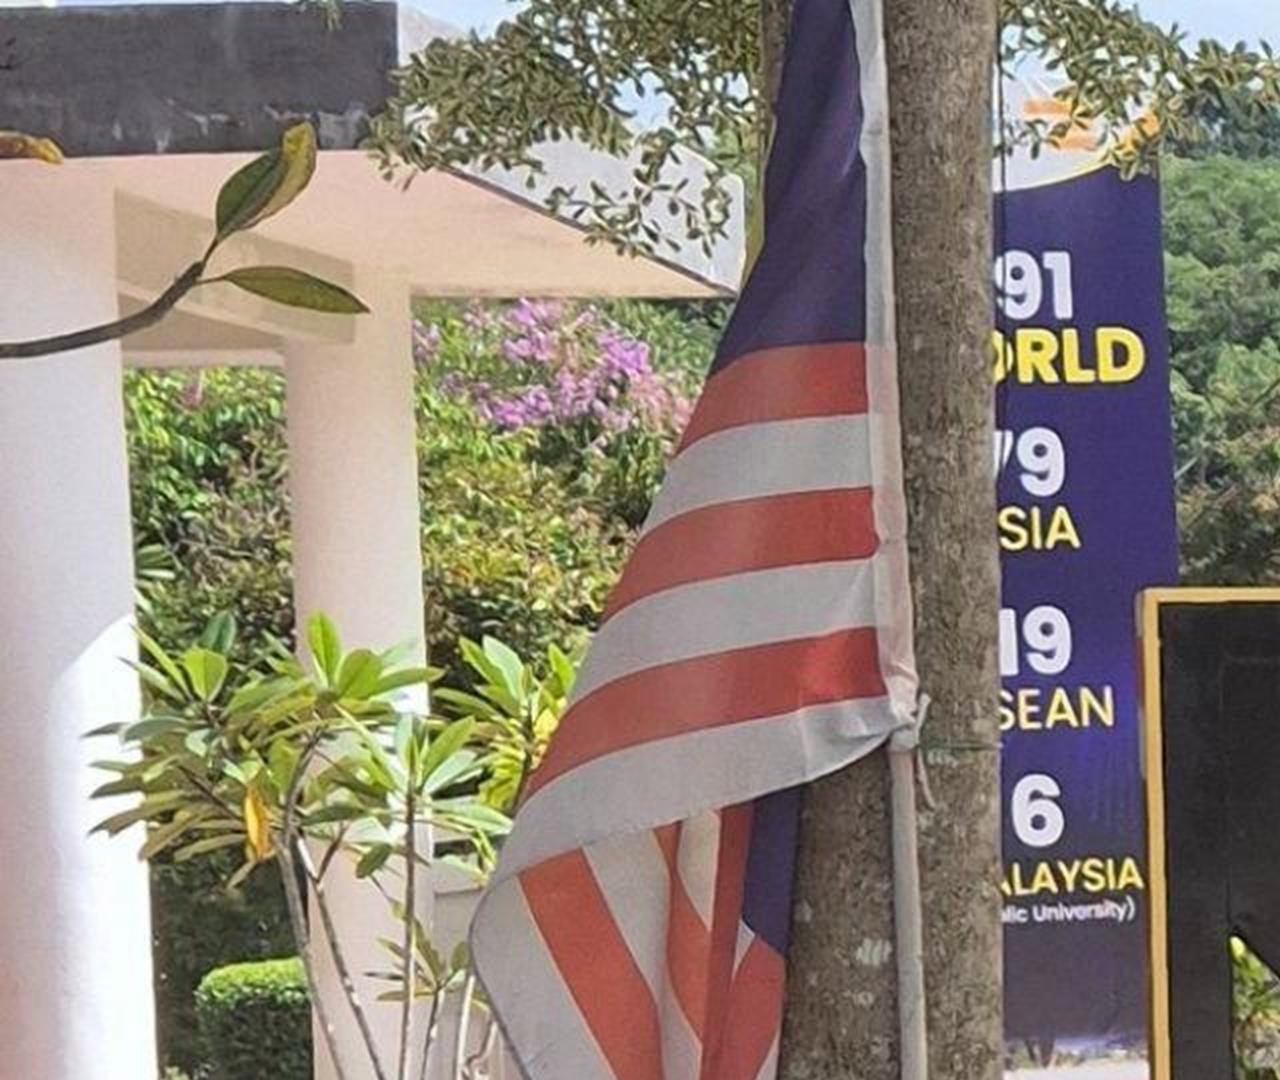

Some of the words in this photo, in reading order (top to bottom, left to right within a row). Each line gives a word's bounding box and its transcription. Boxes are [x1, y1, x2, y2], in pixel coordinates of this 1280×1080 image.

[998, 505, 1081, 550] SIA
[998, 605, 1072, 676] 19
[1011, 774, 1066, 849] 6
